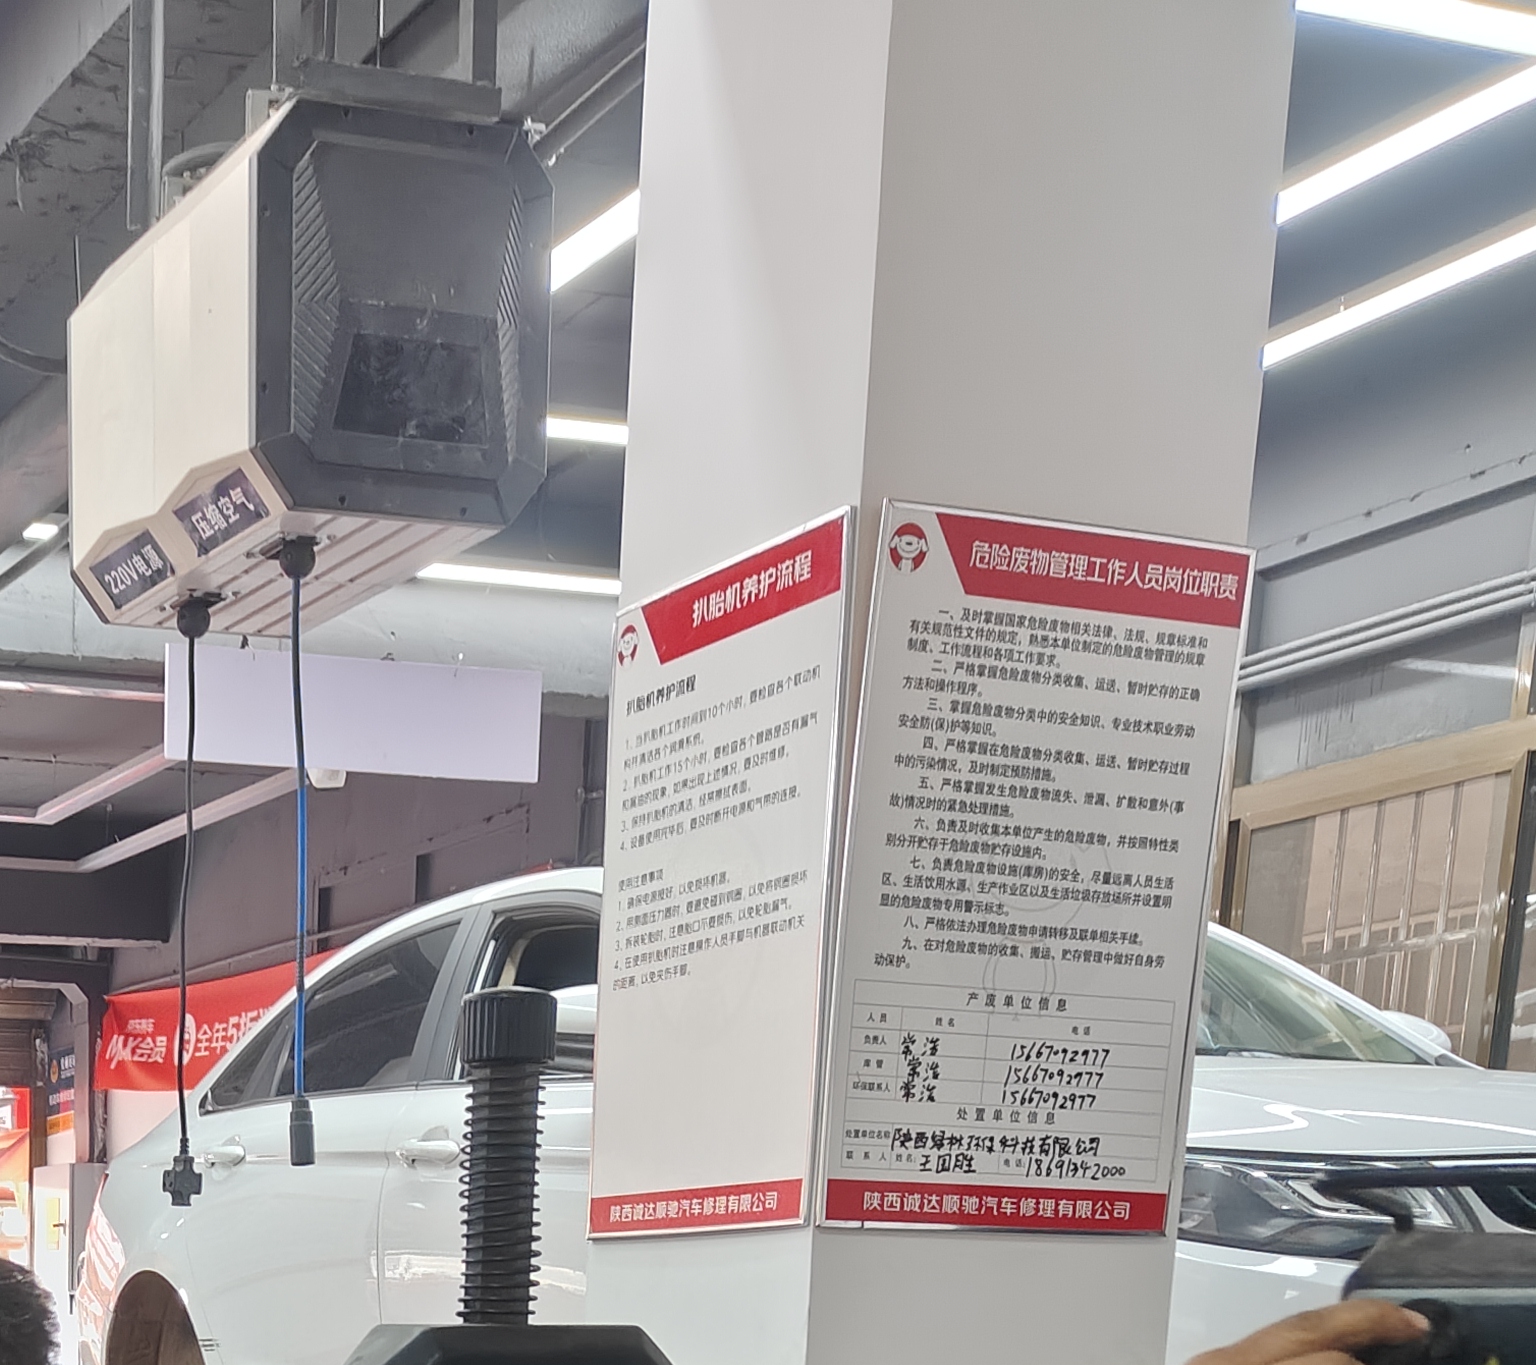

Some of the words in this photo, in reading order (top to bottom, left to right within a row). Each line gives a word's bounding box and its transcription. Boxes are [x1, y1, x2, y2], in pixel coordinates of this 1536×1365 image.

[191, 486, 255, 540] 压缩空气
[105, 544, 164, 594] 220V电源
[692, 549, 812, 628] 扒胎机养护流程
[969, 540, 1239, 601] 危险废物管理工作人员岗位职责
[966, 992, 1068, 1012] 产废单位信息
[956, 1107, 1057, 1125] 处置单位信息
[609, 1191, 778, 1223] 陕西诚达顺驰汽车修理有限公司
[863, 1191, 1131, 1220] 陕西诚达顺驰汽车修理有限公司
